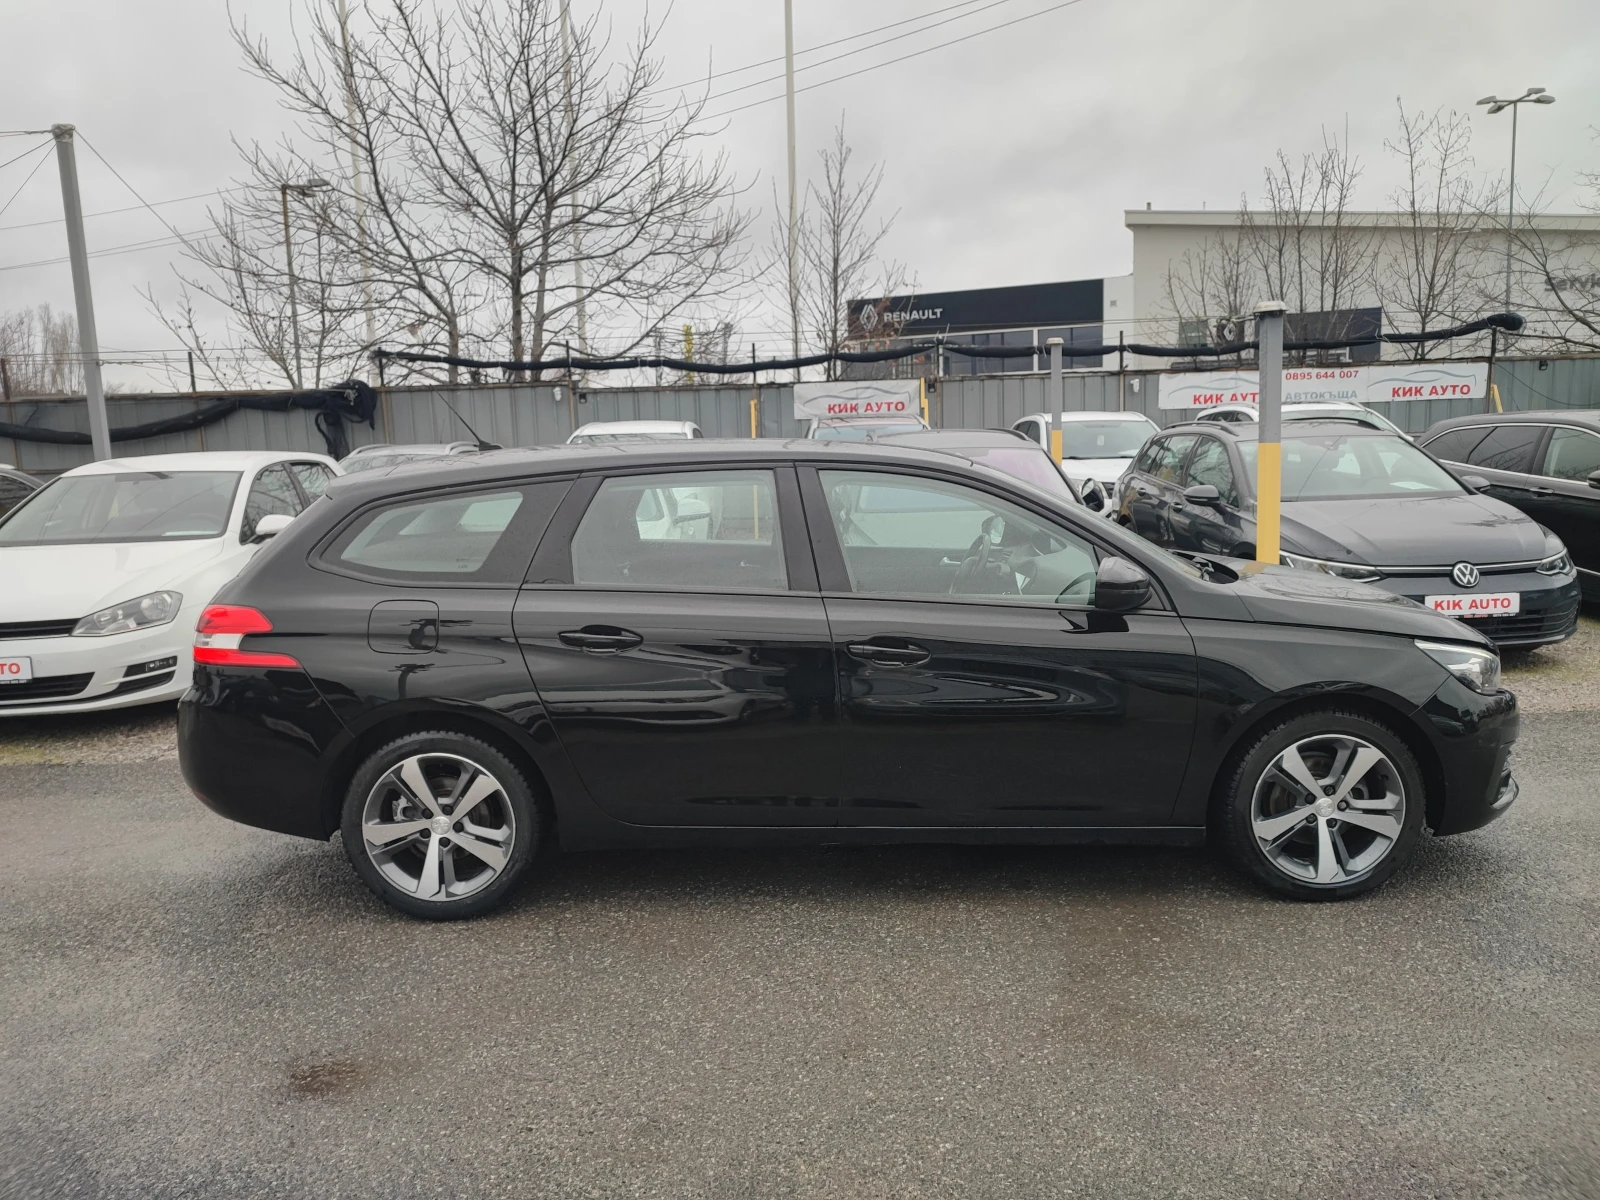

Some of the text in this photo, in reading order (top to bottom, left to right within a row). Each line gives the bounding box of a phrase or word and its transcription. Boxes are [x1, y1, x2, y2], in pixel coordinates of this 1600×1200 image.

[883, 308, 943, 322] RENAULT
[1285, 370, 1359, 380] 0895 644 007
[1285, 390, 1358, 401] АВТОКЪЩА
[1392, 384, 1471, 397] КИК АУТО
[1193, 392, 1259, 404] КИК АУТ
[828, 401, 905, 414] КИК АУТО
[1434, 597, 1511, 611] KIK AUTO
[0, 662, 21, 675] TO
